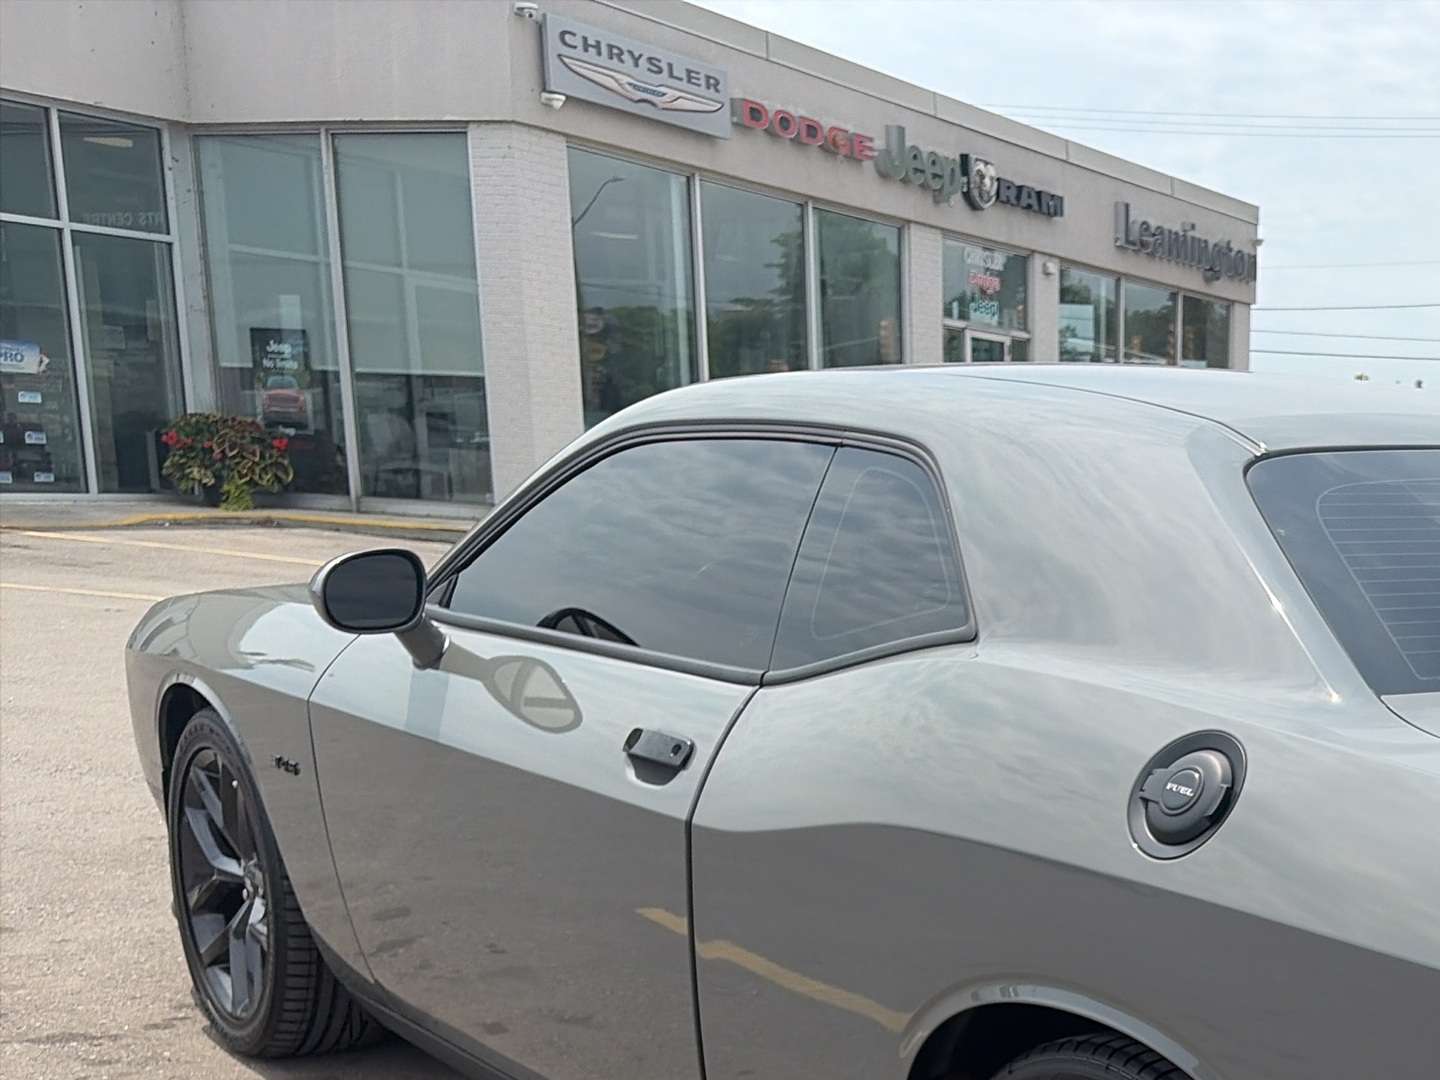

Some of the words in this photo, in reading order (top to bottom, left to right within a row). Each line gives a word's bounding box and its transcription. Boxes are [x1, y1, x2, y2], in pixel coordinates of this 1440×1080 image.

[559, 29, 721, 93] CHRYSLER
[730, 97, 879, 162] DODGE
[874, 124, 961, 204] Jeep
[997, 177, 1064, 217] RAM
[1114, 201, 1257, 284] Leamington
[1165, 782, 1194, 797] FUEL
